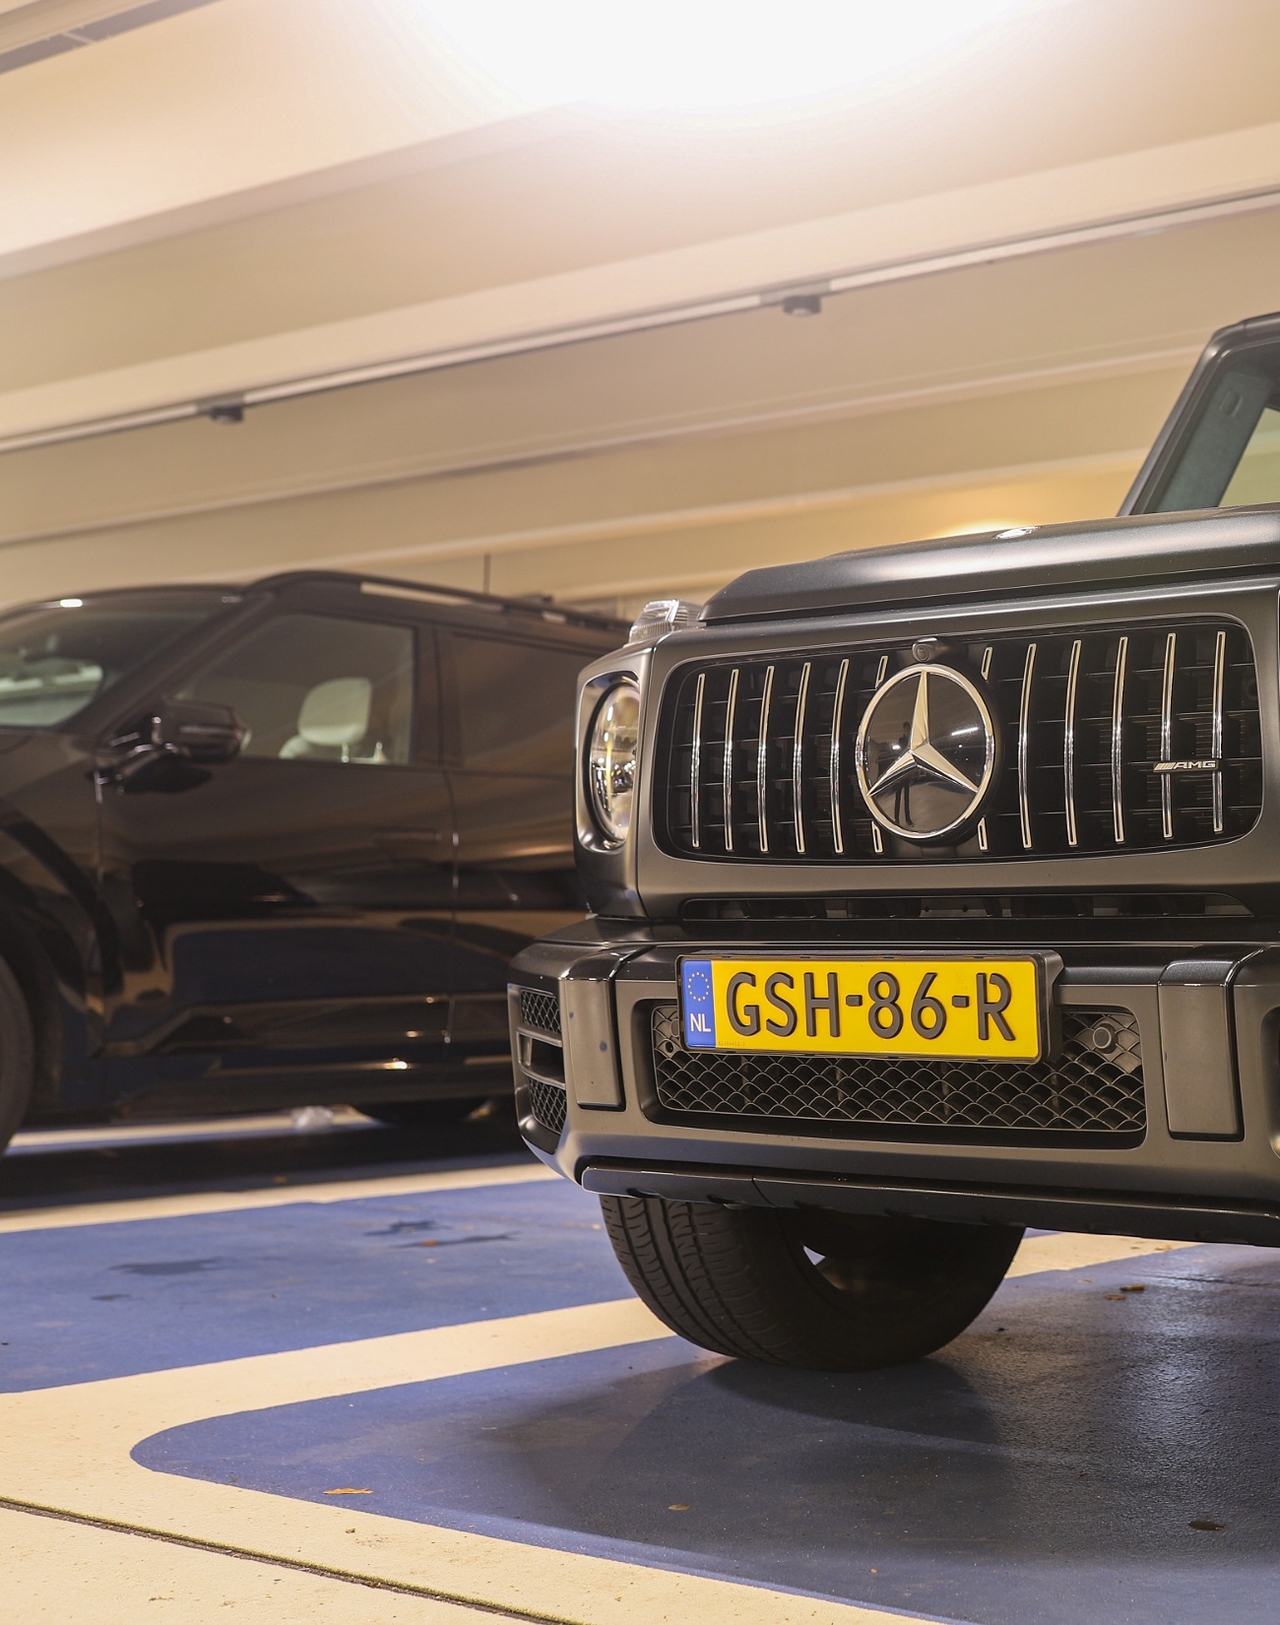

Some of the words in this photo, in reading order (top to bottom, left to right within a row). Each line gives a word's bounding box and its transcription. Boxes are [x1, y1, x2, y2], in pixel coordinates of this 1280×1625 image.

[1173, 761, 1216, 769] AMG
[726, 971, 1016, 1041] GSH-86-R
[690, 1013, 712, 1033] NL
